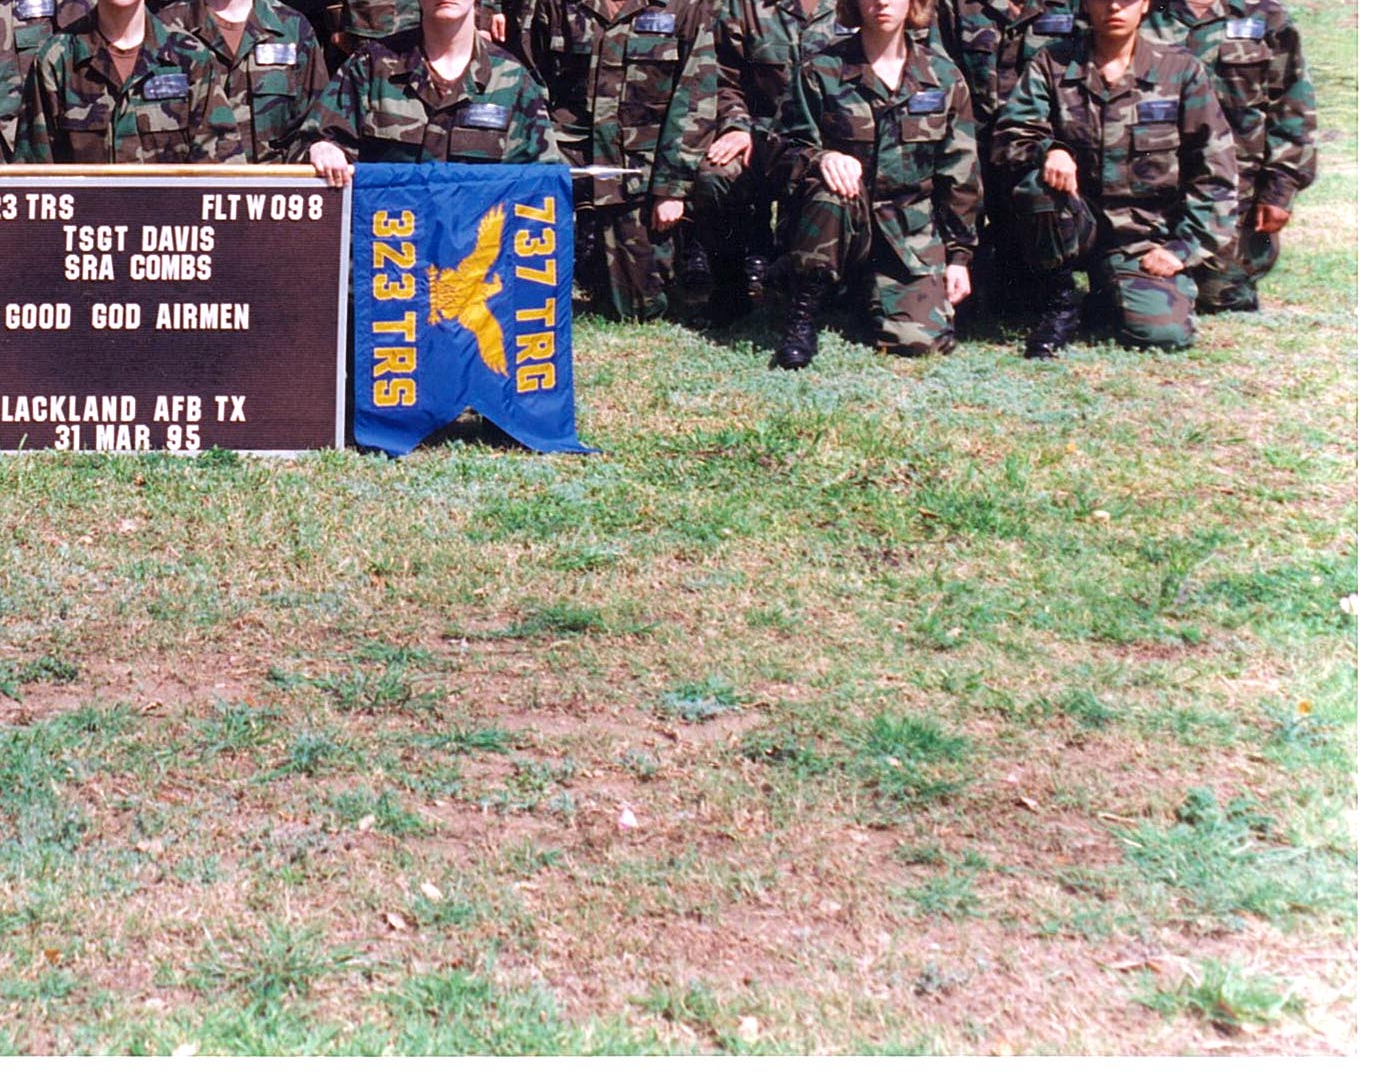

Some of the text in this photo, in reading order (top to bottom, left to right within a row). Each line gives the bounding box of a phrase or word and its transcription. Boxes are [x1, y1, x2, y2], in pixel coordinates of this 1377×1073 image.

[25, 193, 75, 220] TRS
[201, 194, 241, 220] FLT
[63, 225, 215, 252] TSGT DAVIS
[65, 254, 212, 281] SRA COMBS
[372, 210, 417, 407] 323 TRS
[514, 197, 557, 393] 737 TRG
[5, 303, 250, 330] GOOD GOD AIRMEN
[1, 395, 246, 422] LACKLAND AFB TX
[54, 424, 201, 451] 31 MAR 95
